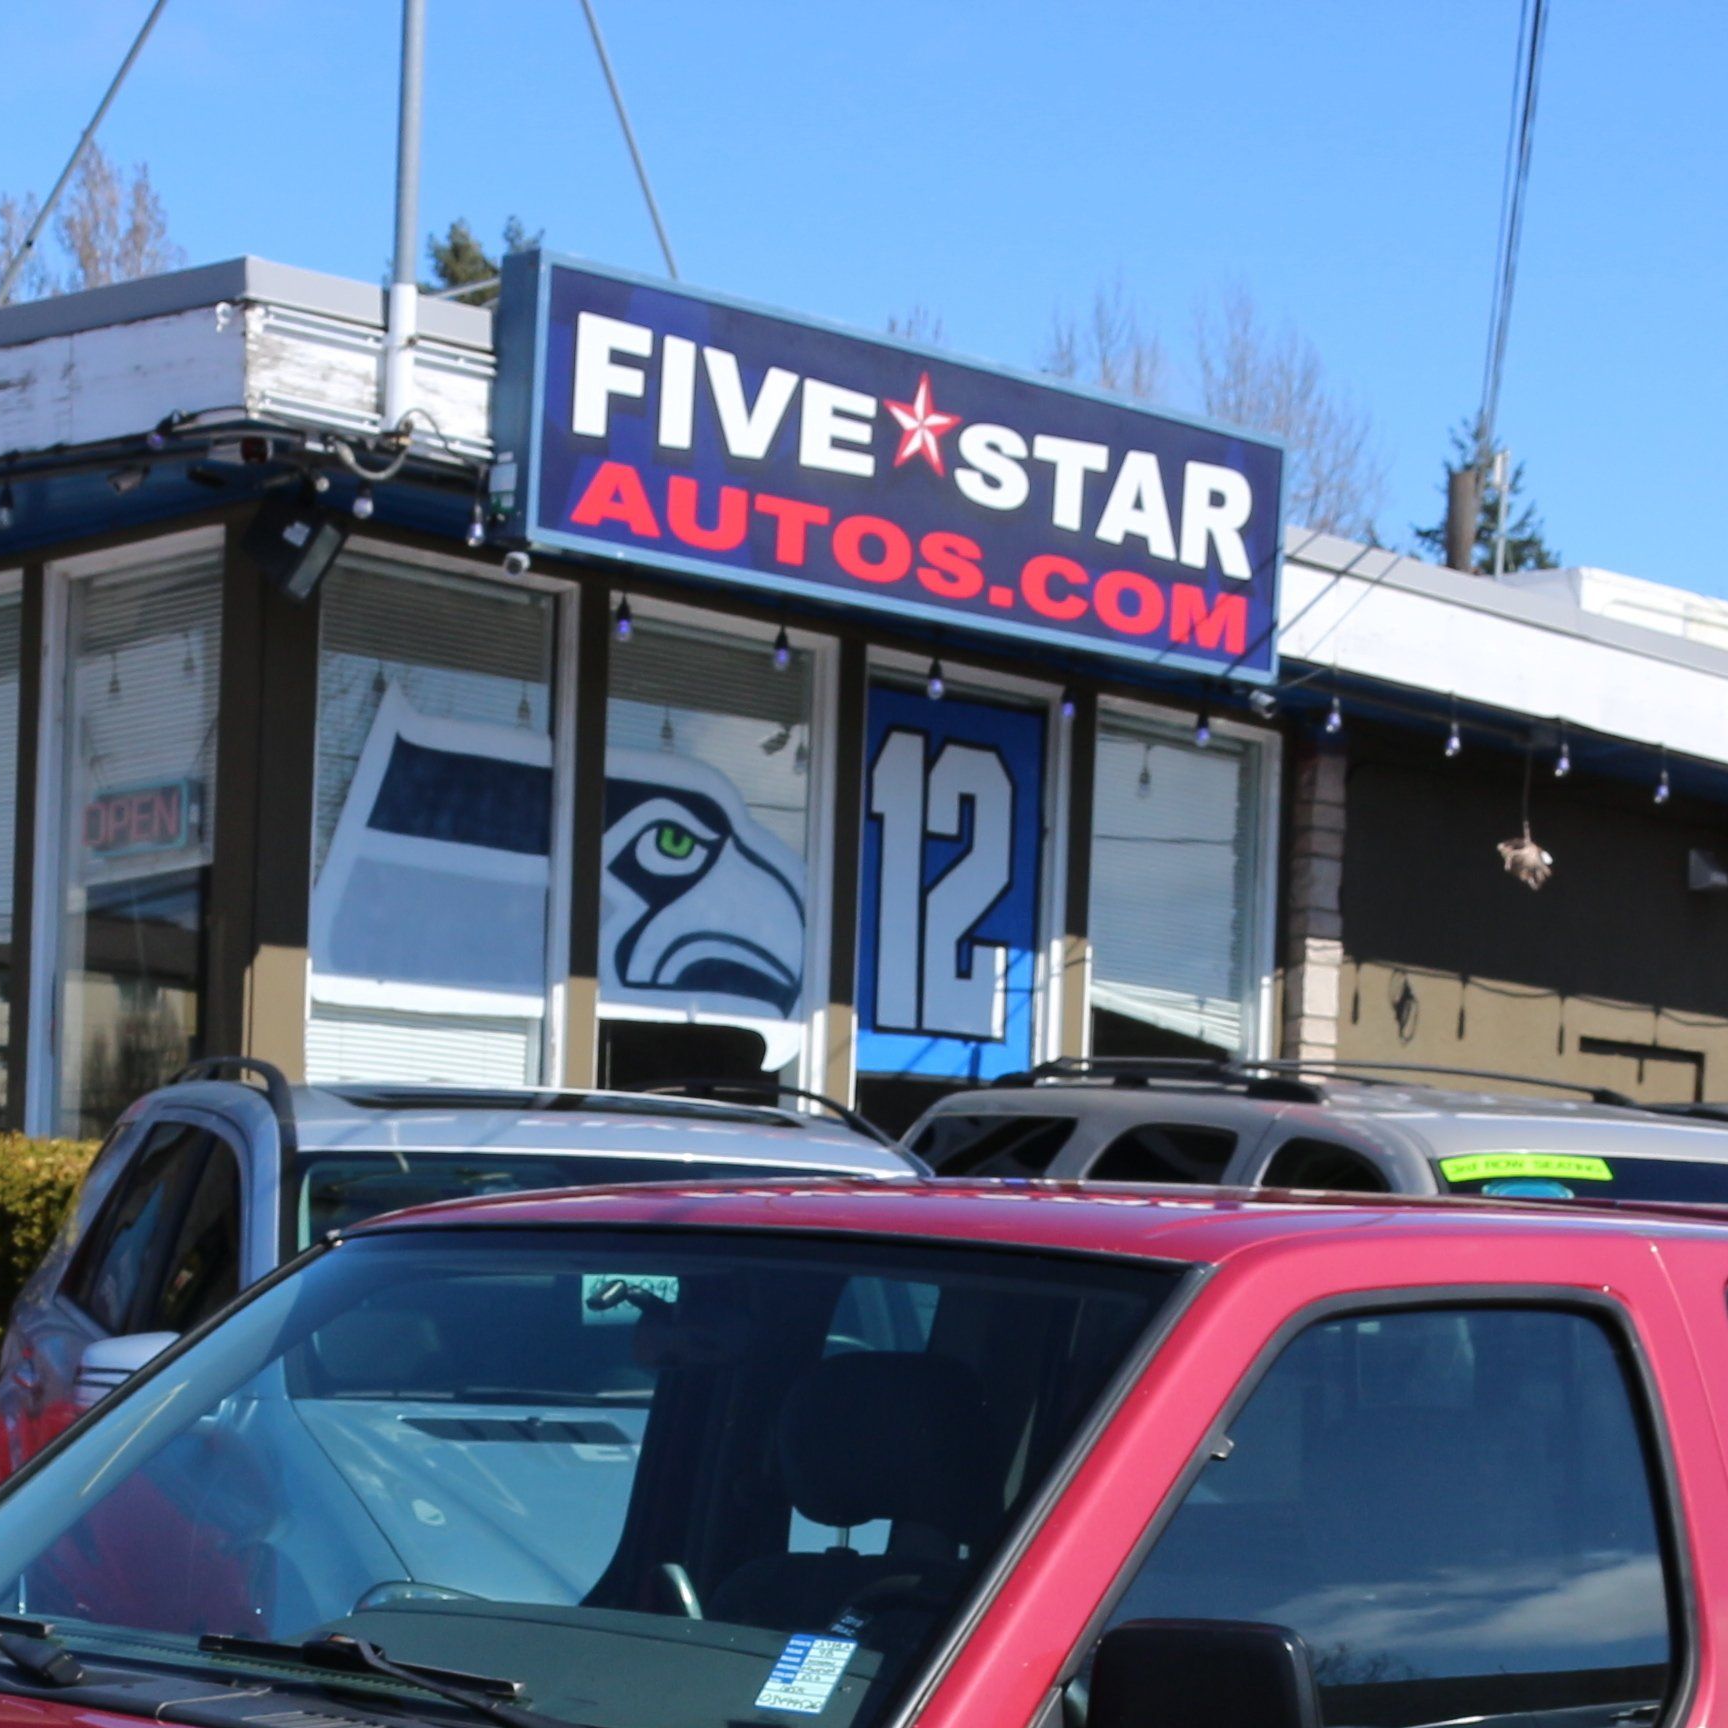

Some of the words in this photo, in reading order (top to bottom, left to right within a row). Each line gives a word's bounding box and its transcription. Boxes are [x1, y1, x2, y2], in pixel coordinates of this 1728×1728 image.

[569, 461, 1250, 656] AUTOS.COM
[571, 310, 880, 478] FIVE
[954, 423, 1255, 581] STAR
[81, 786, 181, 848] OPEN
[869, 728, 1014, 1042] 12
